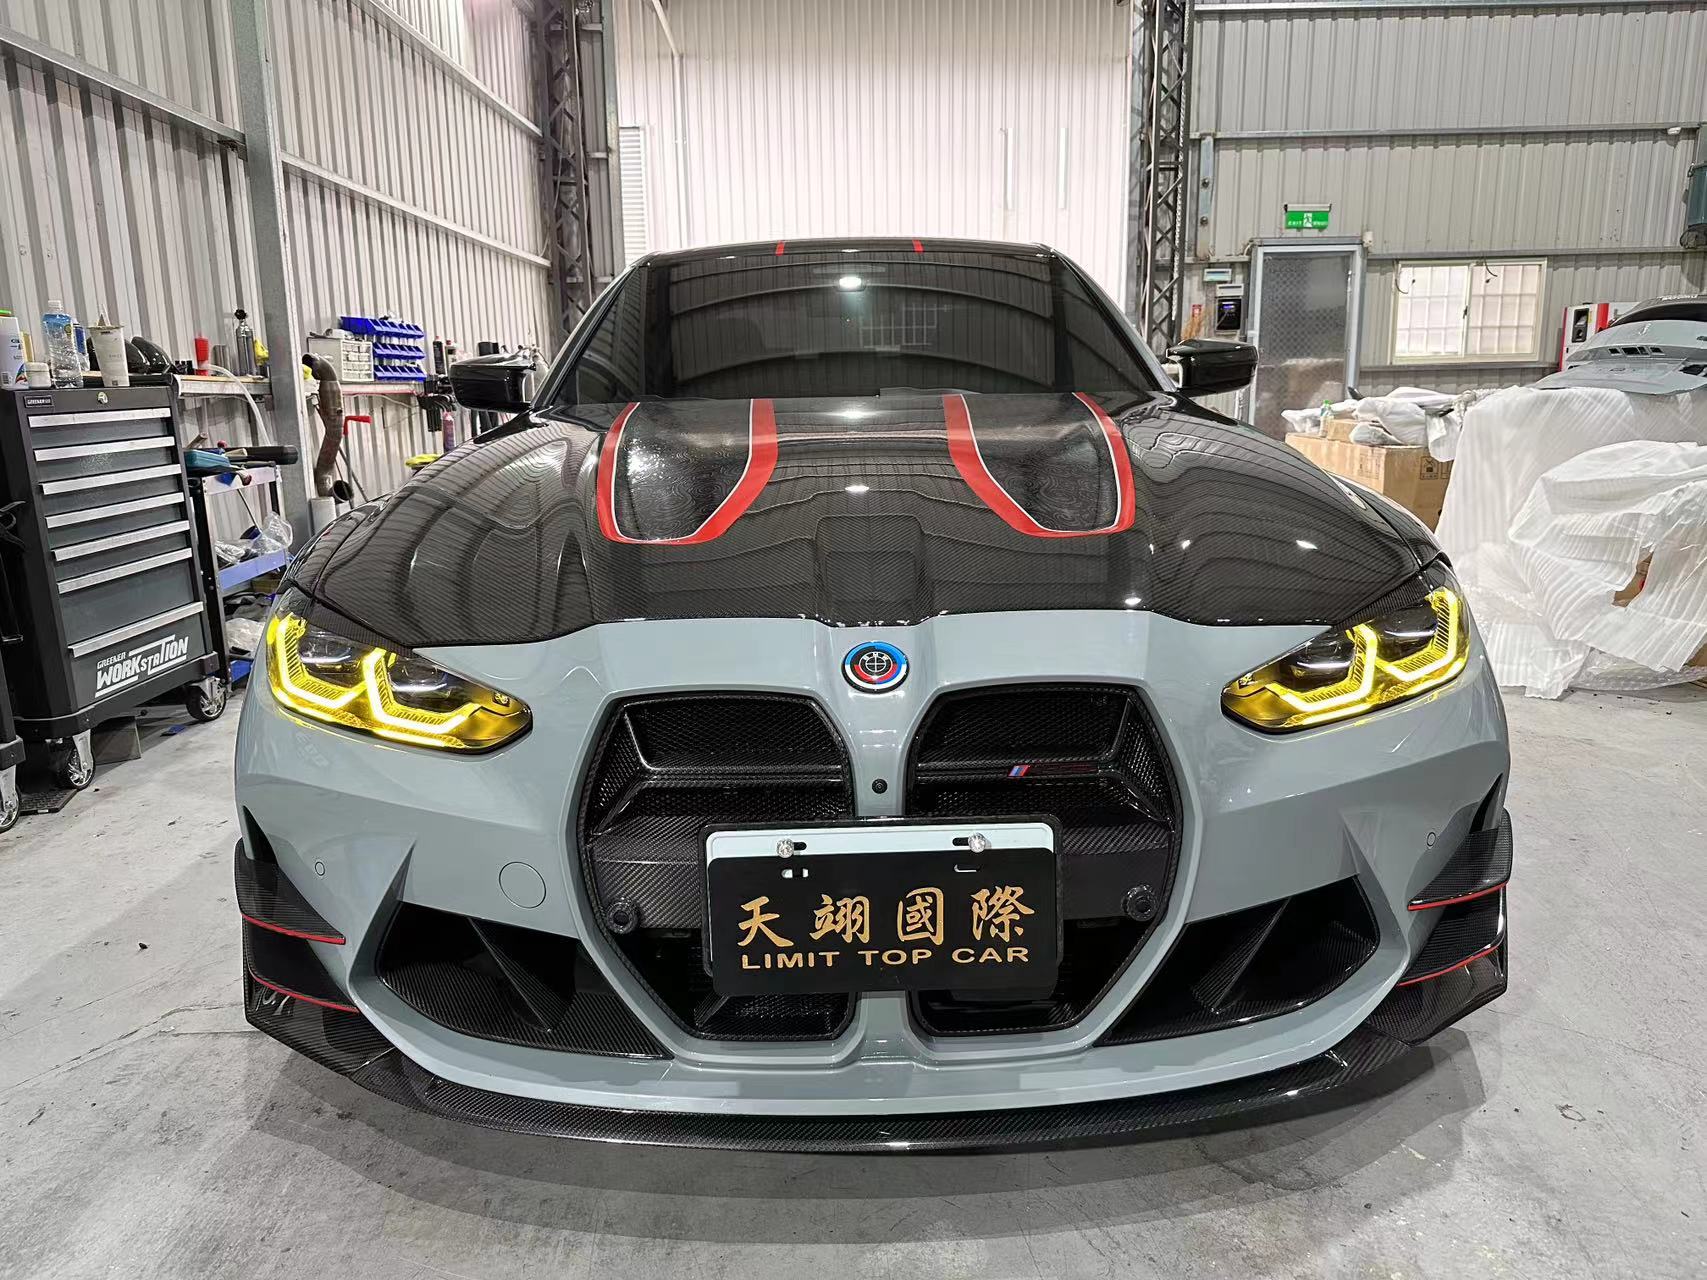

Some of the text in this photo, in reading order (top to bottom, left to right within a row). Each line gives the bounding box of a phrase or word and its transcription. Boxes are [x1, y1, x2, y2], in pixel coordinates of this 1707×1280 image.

[737, 886, 1035, 948] 天翊國際
[741, 947, 1029, 969] LIMIT TOP CAR
